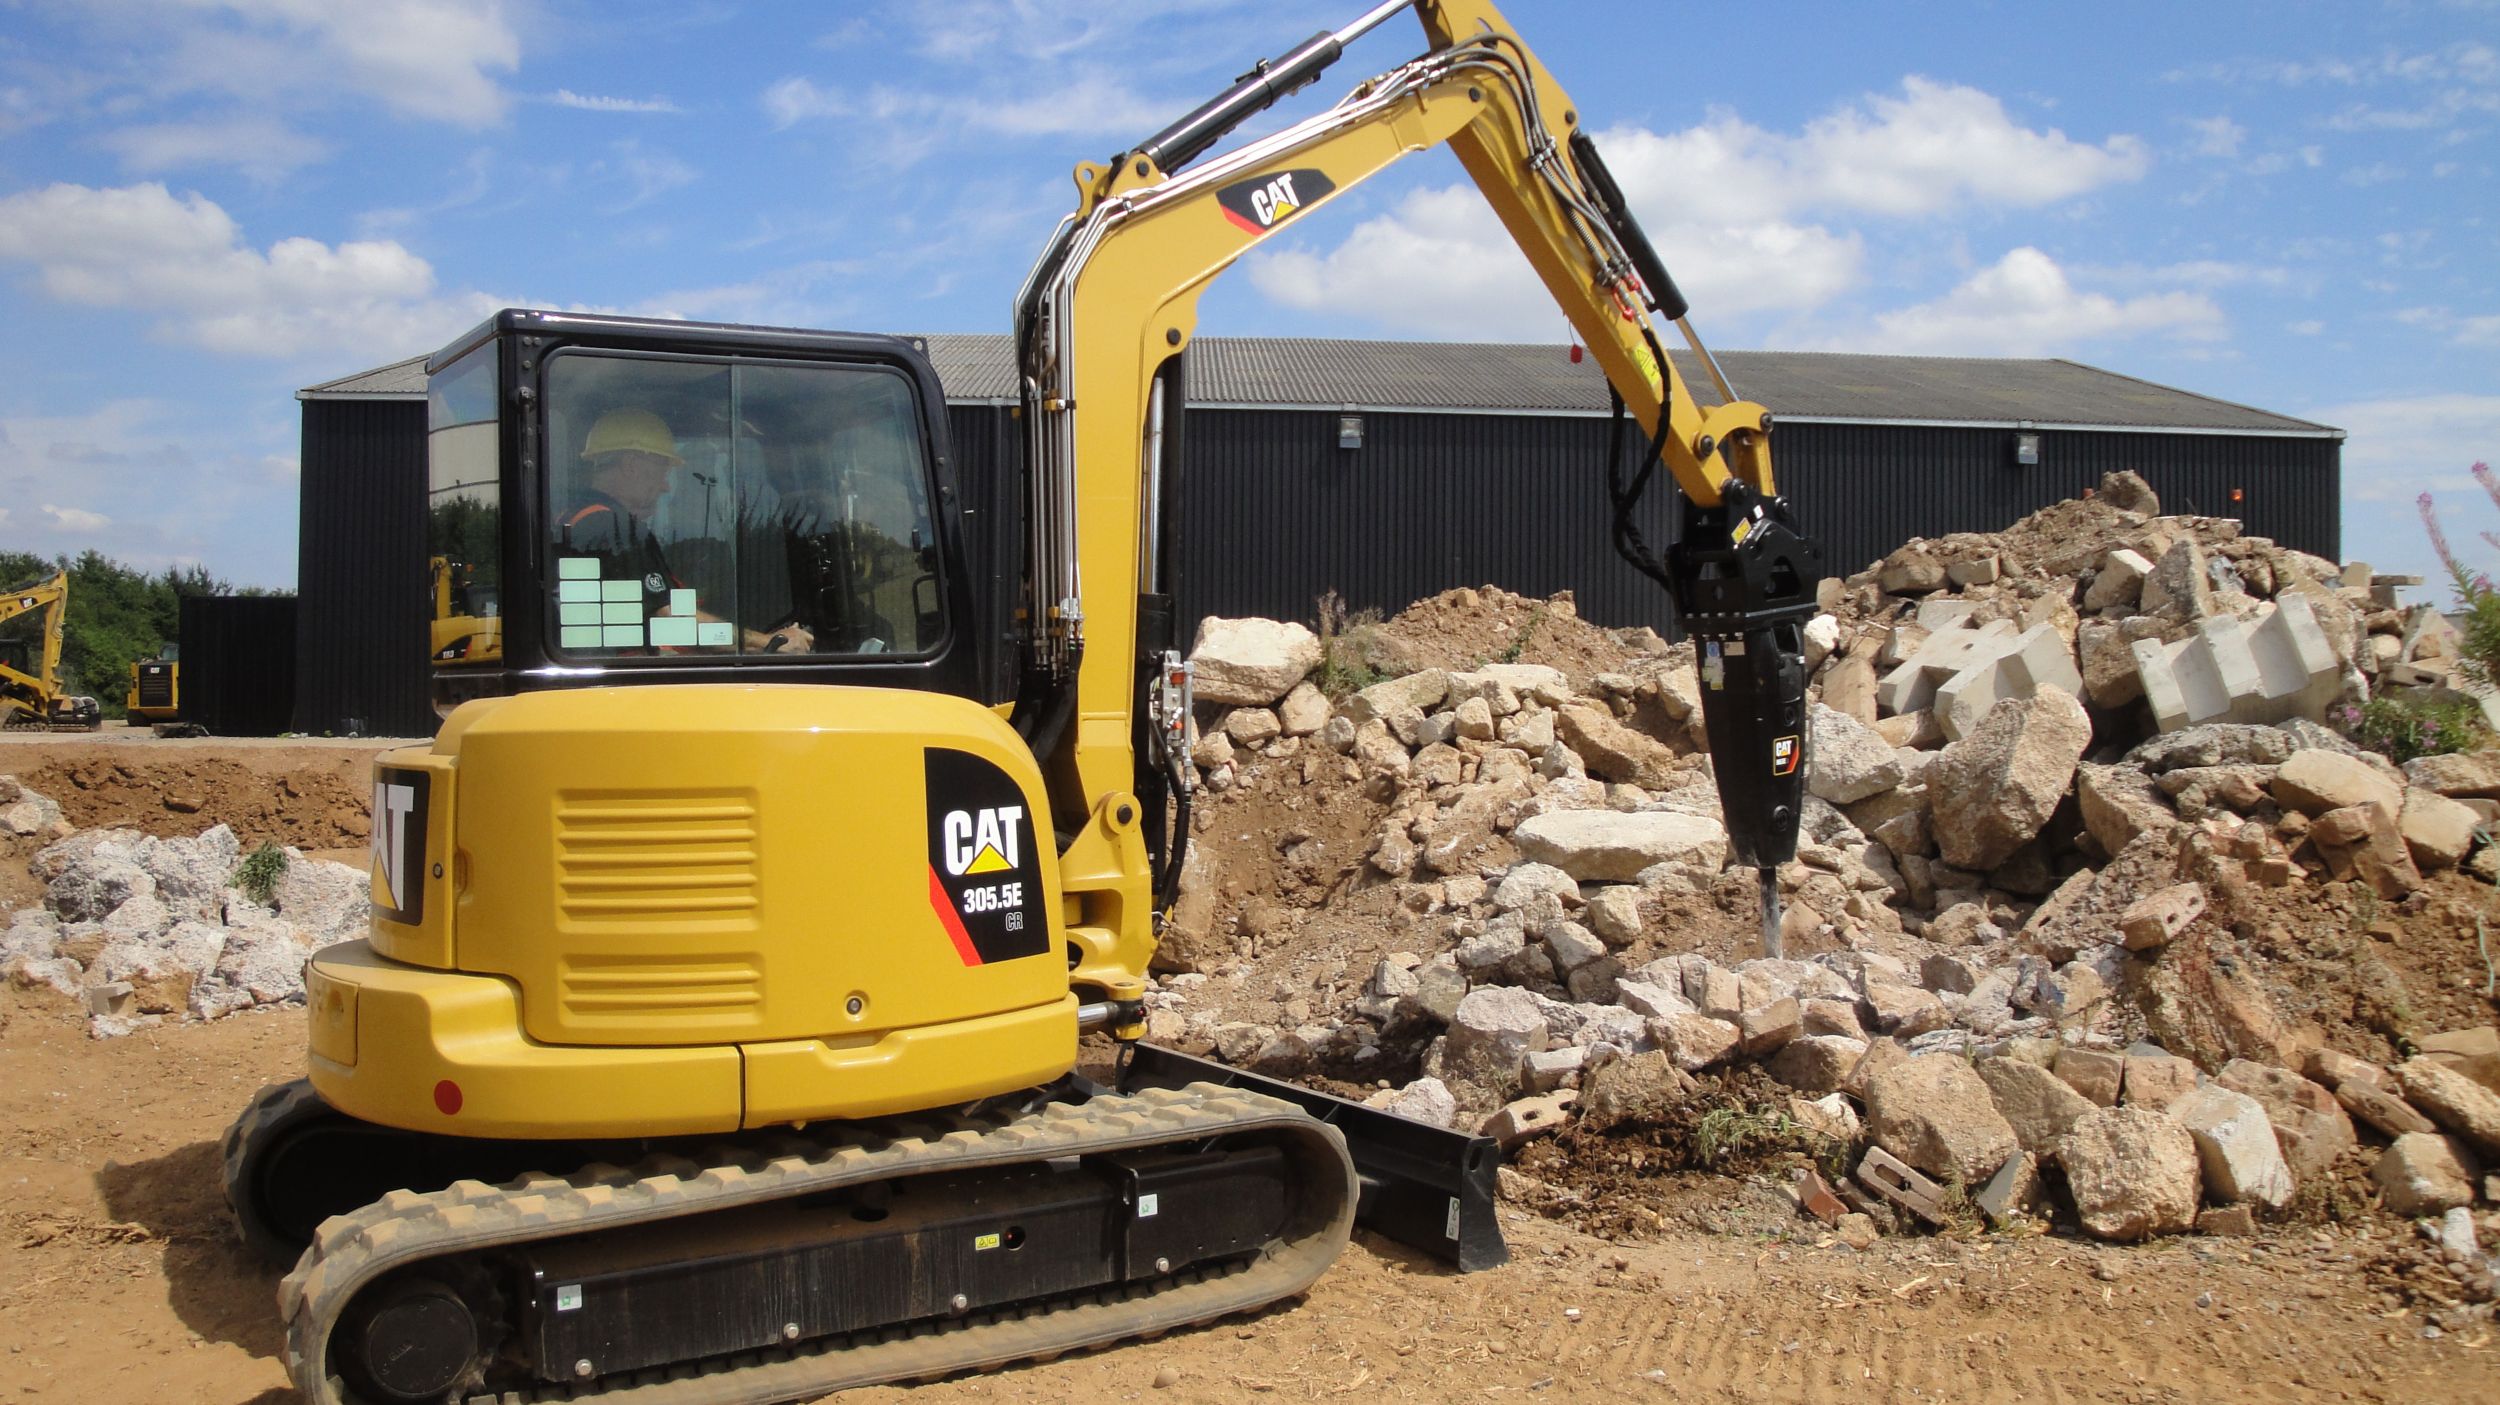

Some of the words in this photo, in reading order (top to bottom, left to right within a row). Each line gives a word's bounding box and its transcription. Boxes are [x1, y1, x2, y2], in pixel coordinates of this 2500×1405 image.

[1251, 172, 1300, 226] CAT
[1776, 740, 1792, 757] CAT
[371, 782, 414, 911] AT
[944, 806, 1022, 875] CAT
[963, 882, 1023, 914] 305.5E
[1006, 912, 1024, 932] CR
